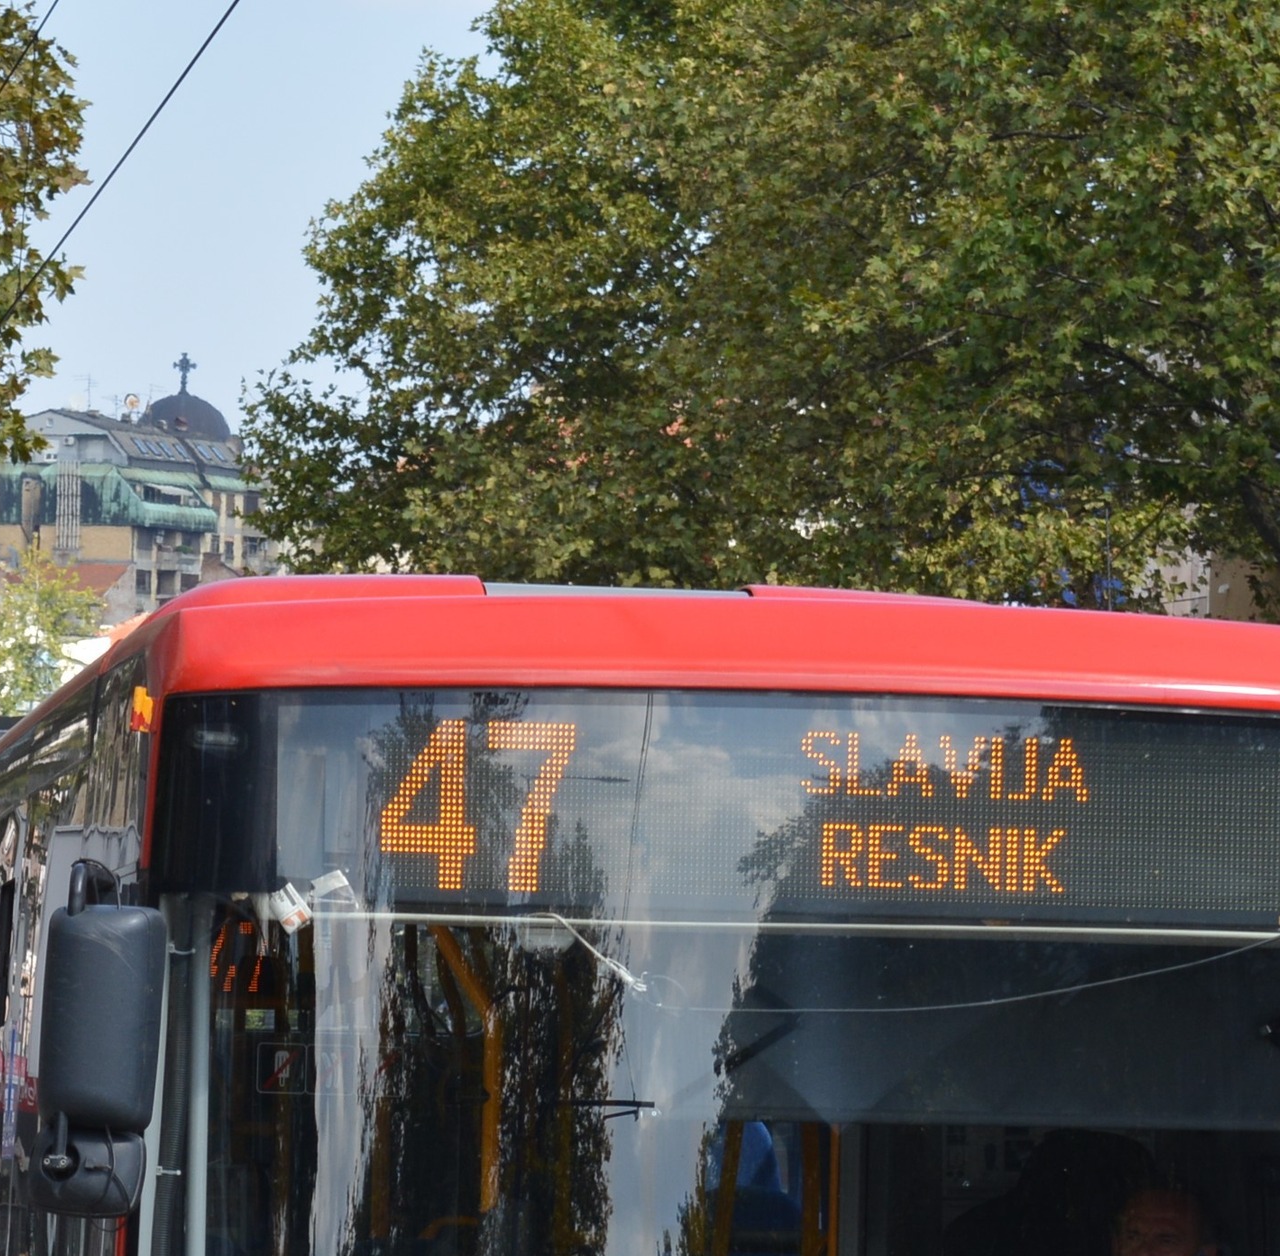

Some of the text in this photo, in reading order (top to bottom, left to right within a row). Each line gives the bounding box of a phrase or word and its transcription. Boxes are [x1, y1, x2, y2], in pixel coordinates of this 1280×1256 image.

[799, 729, 1089, 803] SLAVIJA
[380, 719, 577, 893] 47
[820, 822, 1068, 894] RESNIK
